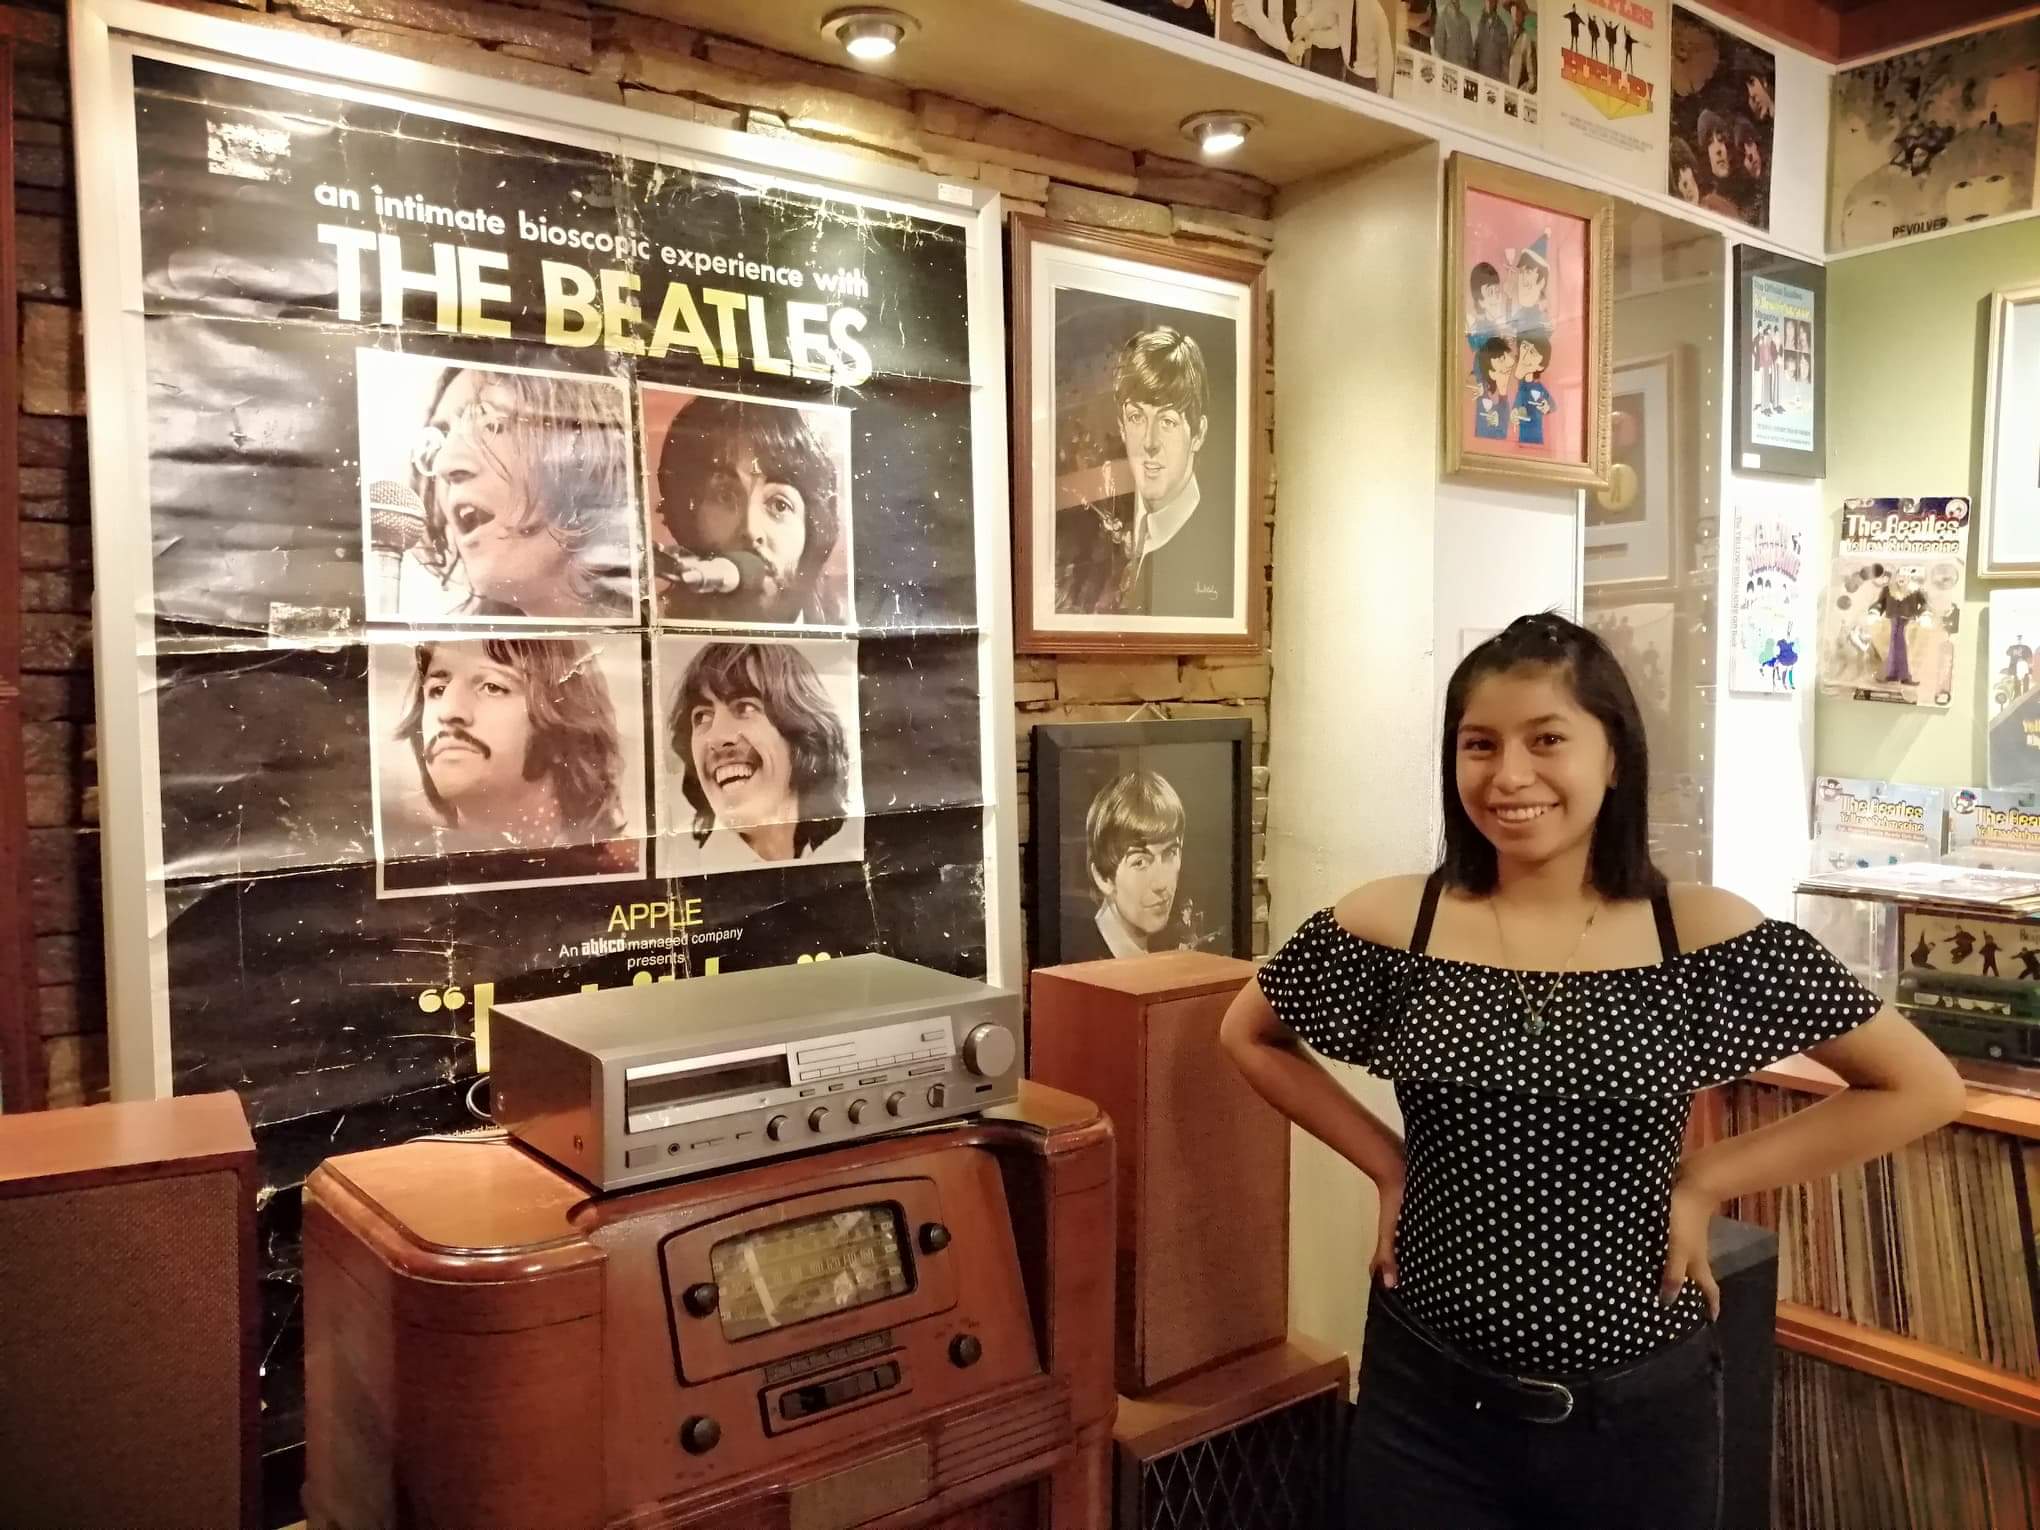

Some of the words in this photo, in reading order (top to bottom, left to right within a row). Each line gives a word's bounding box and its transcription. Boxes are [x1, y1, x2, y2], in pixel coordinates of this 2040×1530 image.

[314, 184, 360, 211] an
[375, 187, 506, 235] intimate
[518, 209, 651, 259] bioscopic
[660, 245, 804, 288] experience
[812, 266, 869, 298] with
[1892, 216, 1949, 240] REVOLVER
[317, 223, 513, 338] THE
[541, 258, 873, 387] BEATLES
[1845, 513, 1883, 538] The
[1886, 512, 1960, 536] Beatles
[1845, 537, 1887, 553] Yellow
[1887, 537, 1960, 553] Submarine
[1840, 793, 1868, 814] The
[1870, 796, 1924, 819] Beatles
[1975, 805, 2007, 826] The
[607, 897, 704, 933] APPLE
[559, 944, 579, 958] An
[627, 933, 689, 951] managed
[691, 927, 744, 946] company
[627, 951, 686, 971] presents
